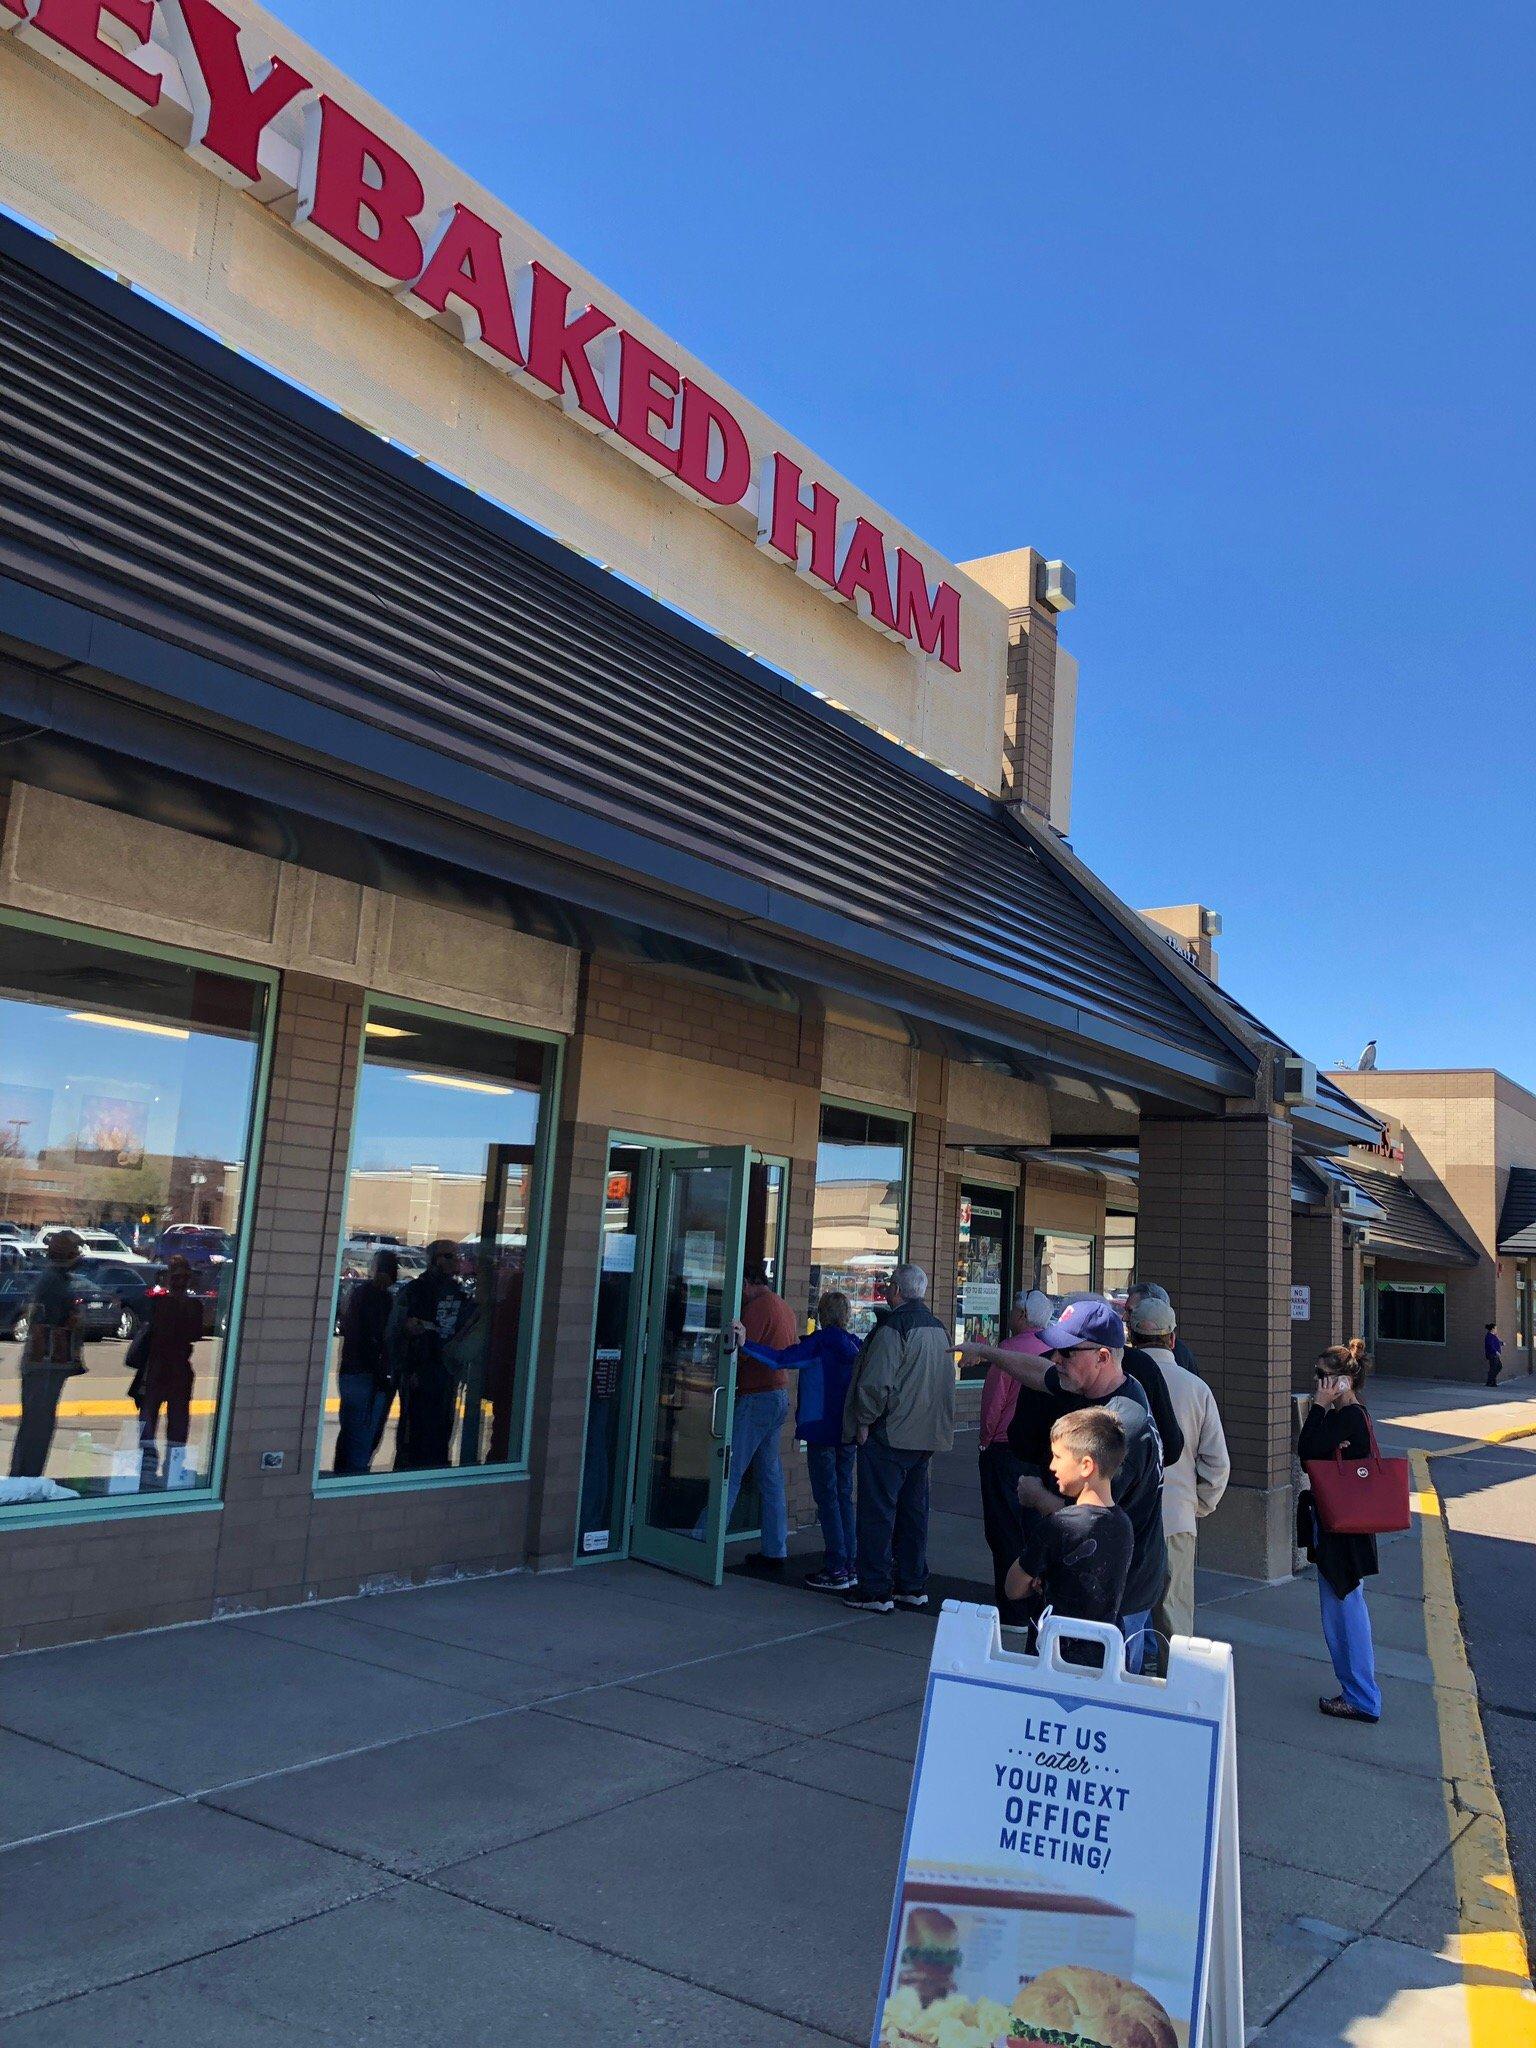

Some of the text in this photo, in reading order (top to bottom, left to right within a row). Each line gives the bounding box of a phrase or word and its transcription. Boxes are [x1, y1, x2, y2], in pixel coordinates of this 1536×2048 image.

[769, 450, 962, 673] HAM
[1024, 1718, 1107, 1754] LET US
[994, 1763, 1130, 1812] YOUR NEXT
[1004, 1796, 1111, 1844] OFFICE
[999, 1827, 1112, 1875] MEETING!
